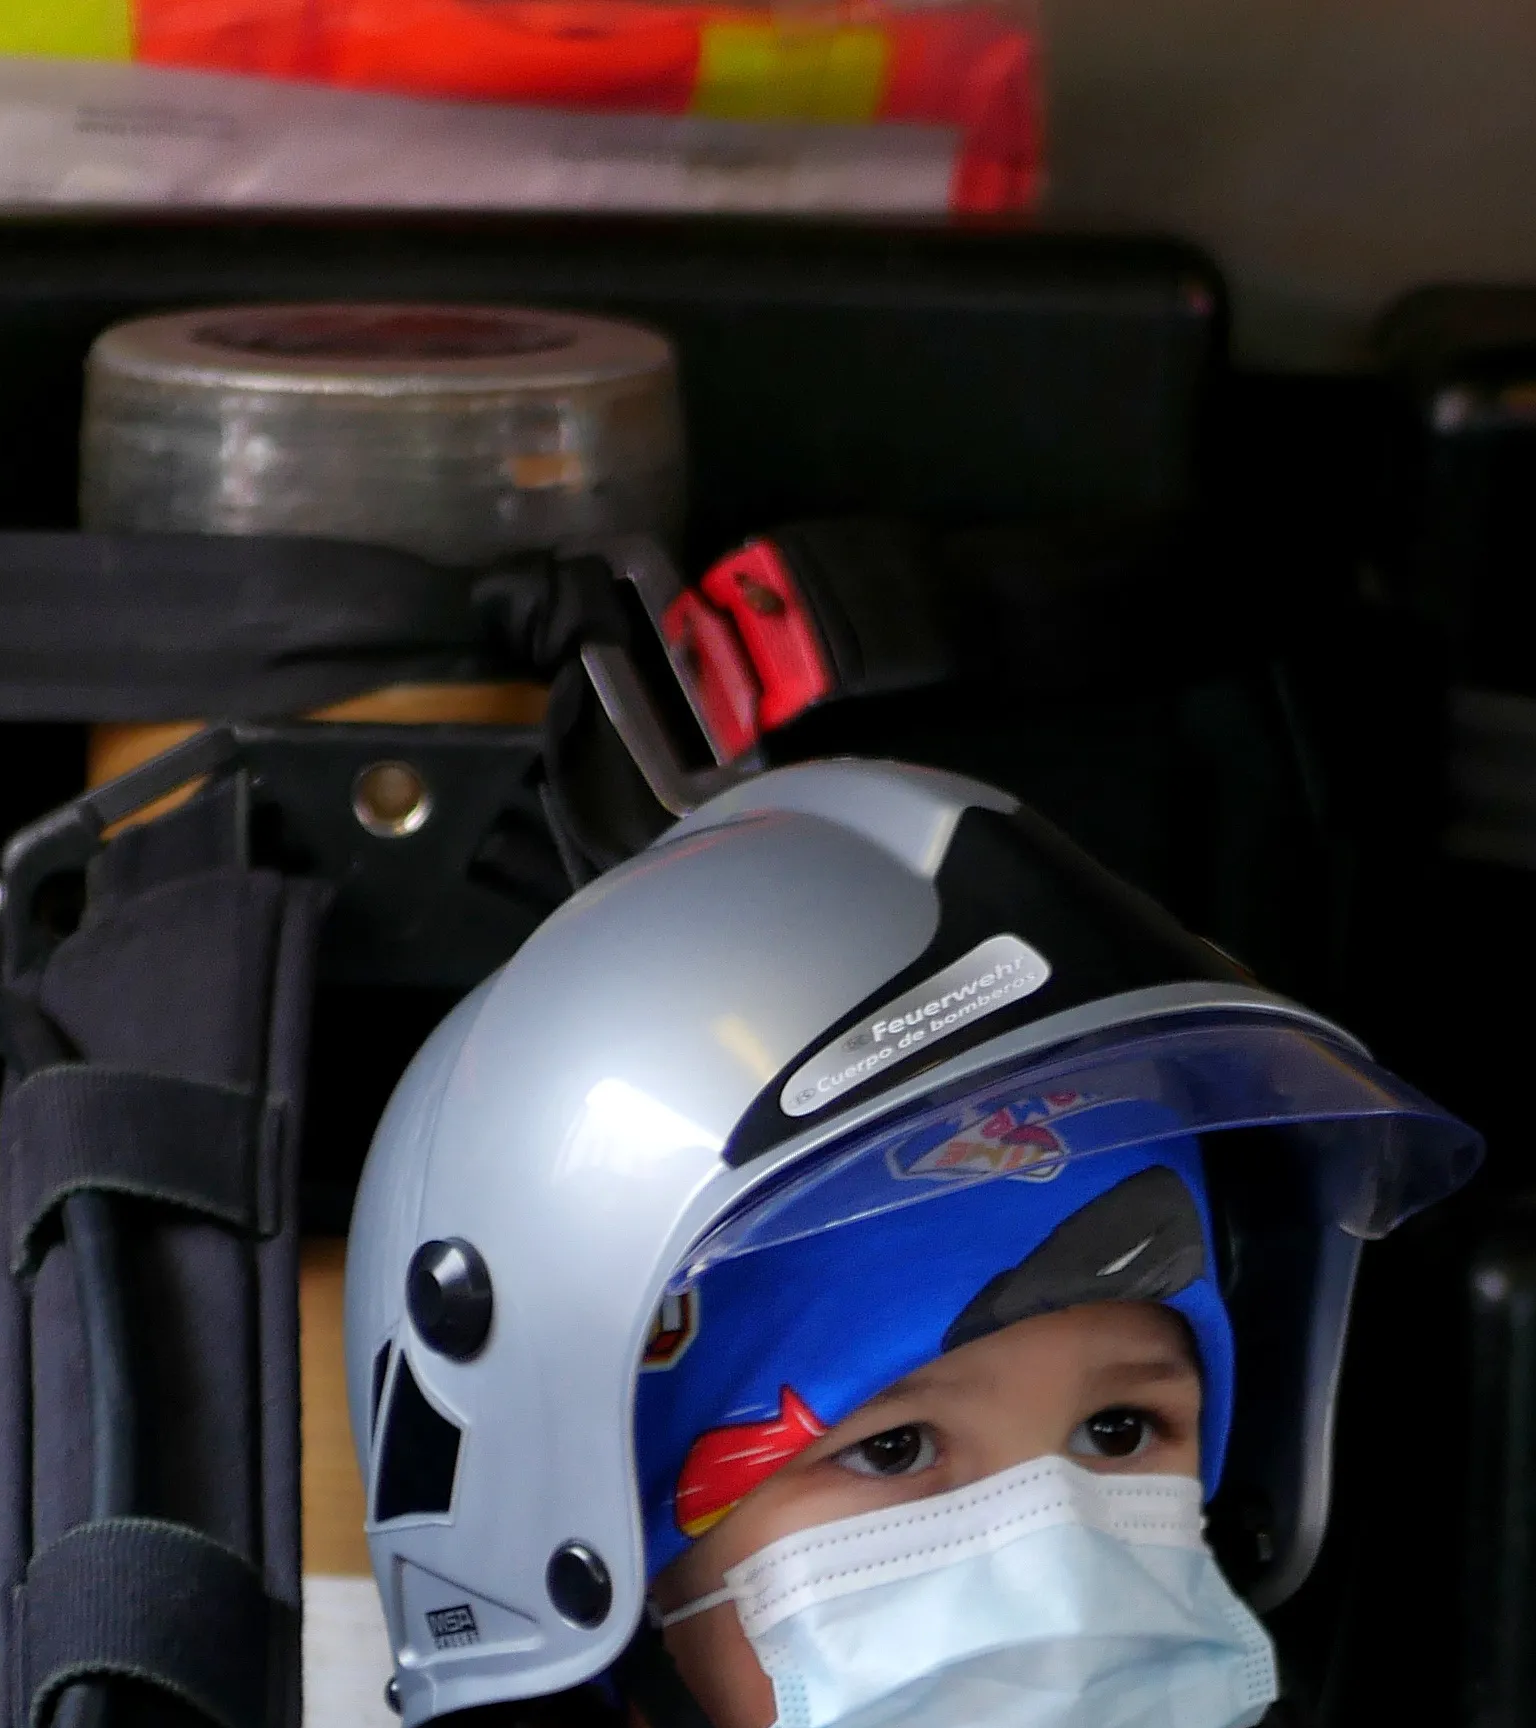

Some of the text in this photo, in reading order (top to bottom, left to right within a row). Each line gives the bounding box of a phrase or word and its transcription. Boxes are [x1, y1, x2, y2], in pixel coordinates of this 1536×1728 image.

[816, 1046, 894, 1093] Cuerpo
[897, 1024, 927, 1051] de
[929, 972, 1037, 1034] bomberos
[870, 956, 1024, 1043] Feuerwehr
